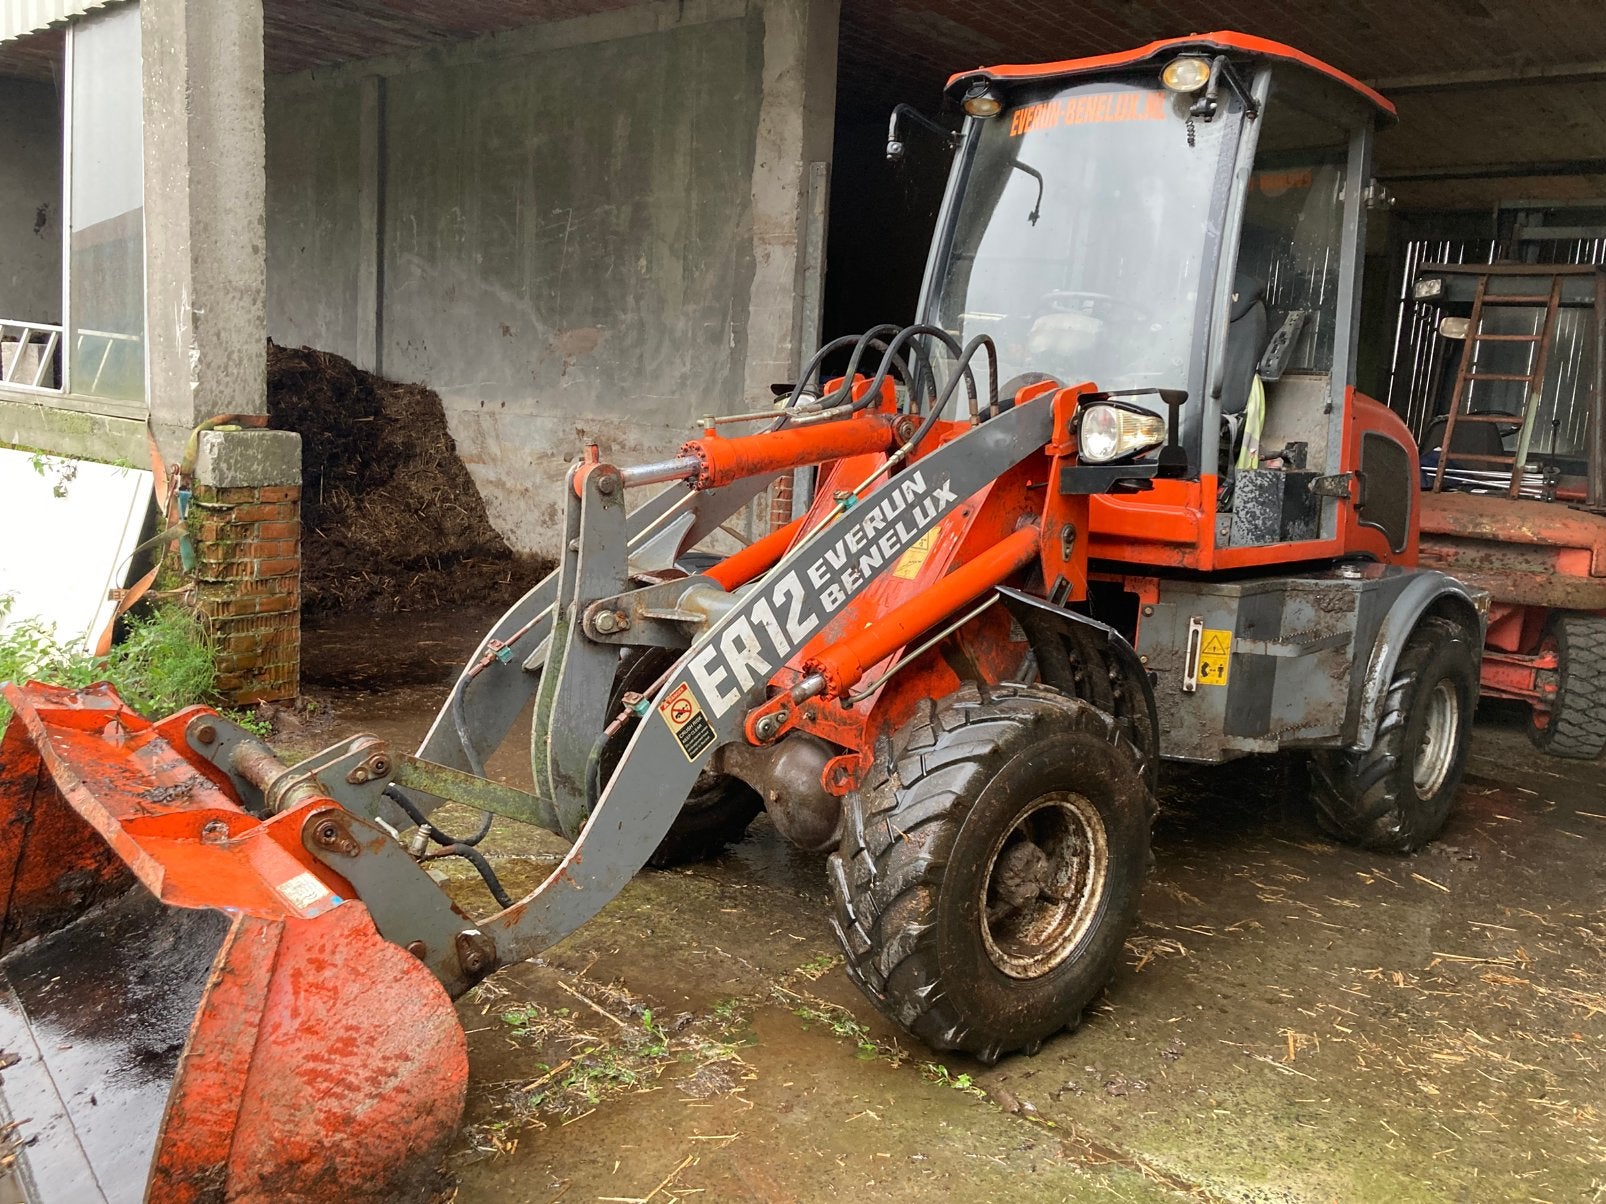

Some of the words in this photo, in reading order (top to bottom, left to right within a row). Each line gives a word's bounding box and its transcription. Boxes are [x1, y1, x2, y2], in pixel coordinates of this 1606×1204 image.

[806, 470, 927, 590] EVERUN
[819, 479, 958, 613] BENELUX
[688, 569, 819, 719] ER12
[679, 724, 693, 739] CRUSH
